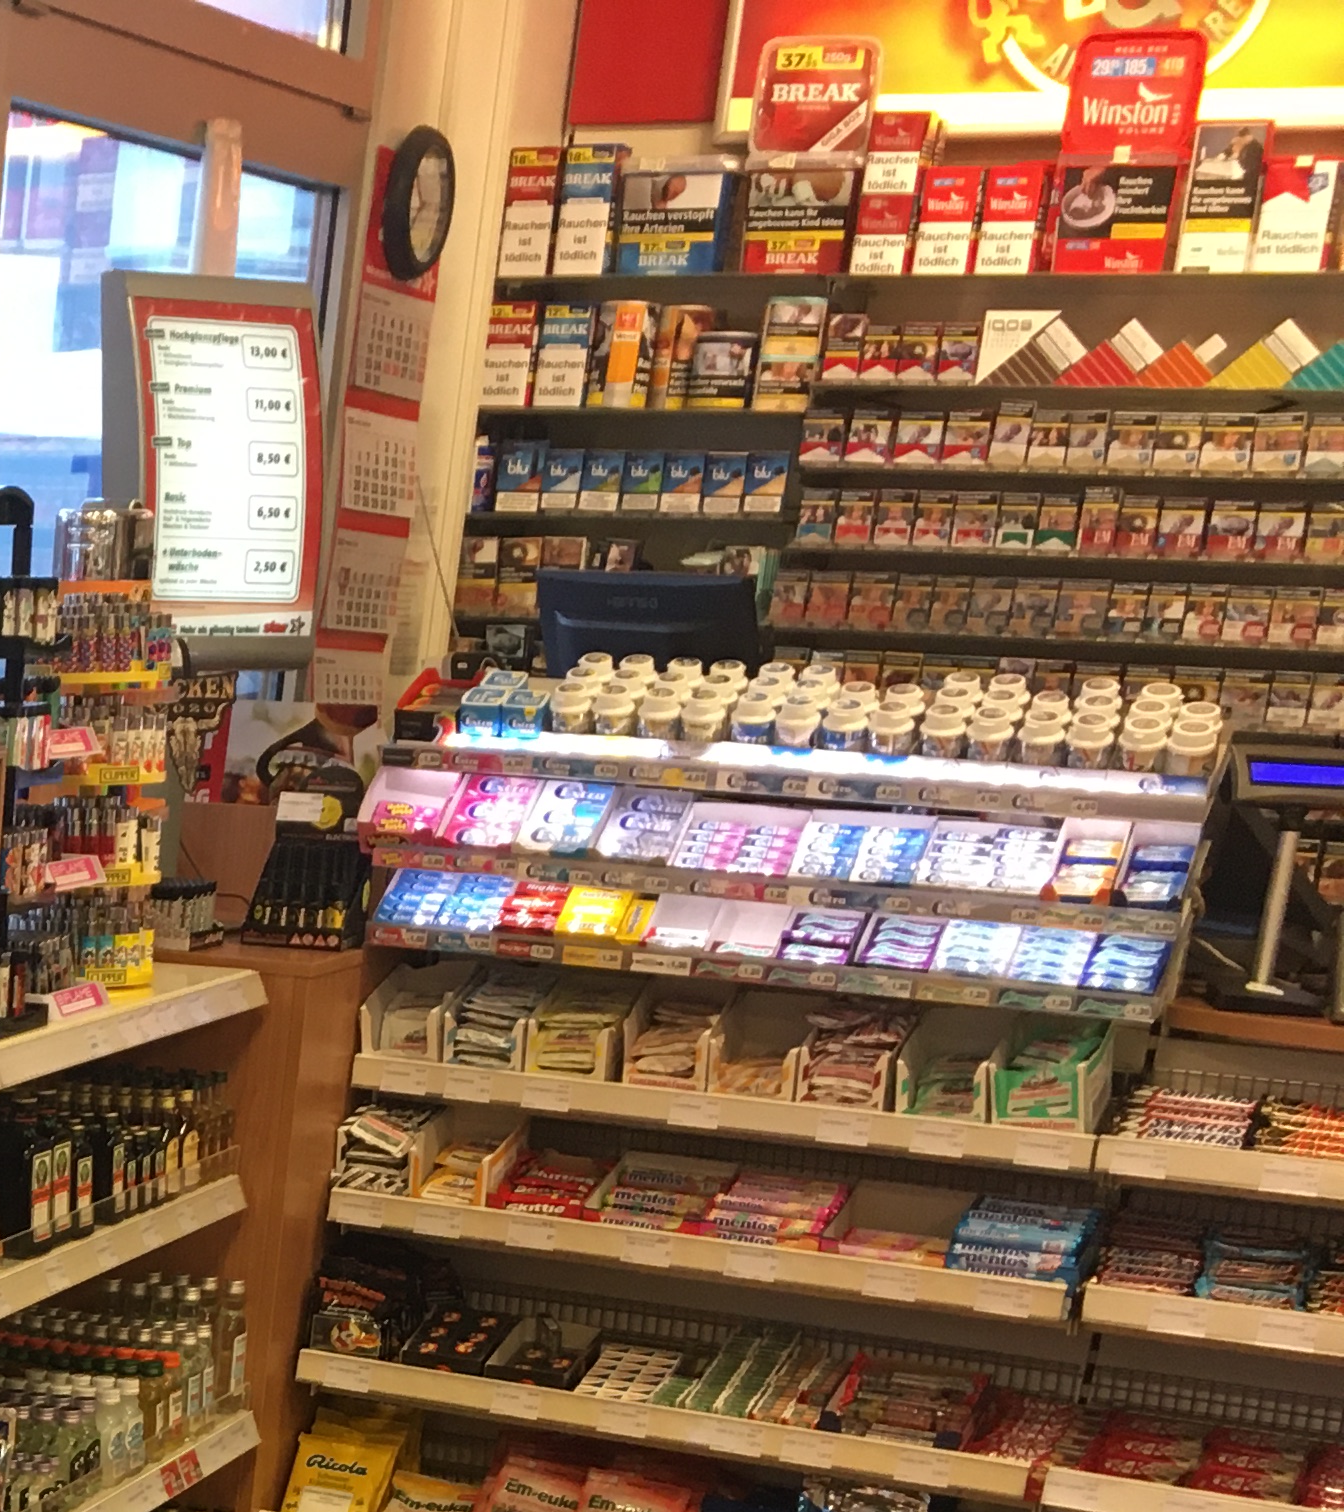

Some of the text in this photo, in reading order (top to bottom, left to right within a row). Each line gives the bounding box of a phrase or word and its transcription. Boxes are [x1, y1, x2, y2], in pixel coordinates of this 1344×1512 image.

[770, 83, 860, 102] BREAK
[1082, 94, 1168, 126] Winston
[867, 155, 918, 165] Rauchen
[565, 172, 612, 184] BREAK
[882, 167, 896, 177] ist
[510, 175, 555, 188] BREAK
[867, 177, 908, 190] tödlich
[927, 198, 965, 211] Winston
[990, 198, 1028, 211] Winston
[667, 208, 714, 221] verstopft
[784, 208, 805, 217] kann
[642, 223, 684, 233] Arterien
[800, 217, 819, 226] Kind
[917, 231, 969, 241] Rauchen
[980, 230, 1032, 241] Rauchen
[1262, 230, 1318, 240] Rauchen
[854, 238, 905, 248] Rauchen
[933, 244, 948, 254] ist
[996, 244, 1011, 254] ist
[1275, 243, 1319, 254] tödlich
[638, 254, 688, 266] BREAK
[765, 252, 818, 265] BREAK
[869, 250, 883, 260] ist
[919, 254, 959, 267] tödlich
[981, 254, 1021, 267] tödlich
[855, 260, 894, 273] tödlich
[1104, 256, 1140, 269] Winston
[250, 346, 277, 359] 13,00
[175, 383, 281, 412] Premium 11,00
[177, 438, 280, 465] Top 8,50
[507, 459, 529, 475] blu
[550, 463, 567, 477] blu
[591, 463, 608, 476] blu
[631, 464, 647, 477] blu
[164, 492, 280, 519] Basic 6,50
[254, 561, 276, 573] 2,50
[1150, 1128, 1243, 1147] SNICKERS
[615, 1189, 677, 1206] mentos
[714, 1216, 777, 1233] mentos
[306, 1454, 367, 1476] Ricola
[506, 1478, 578, 1511] Em-euka
